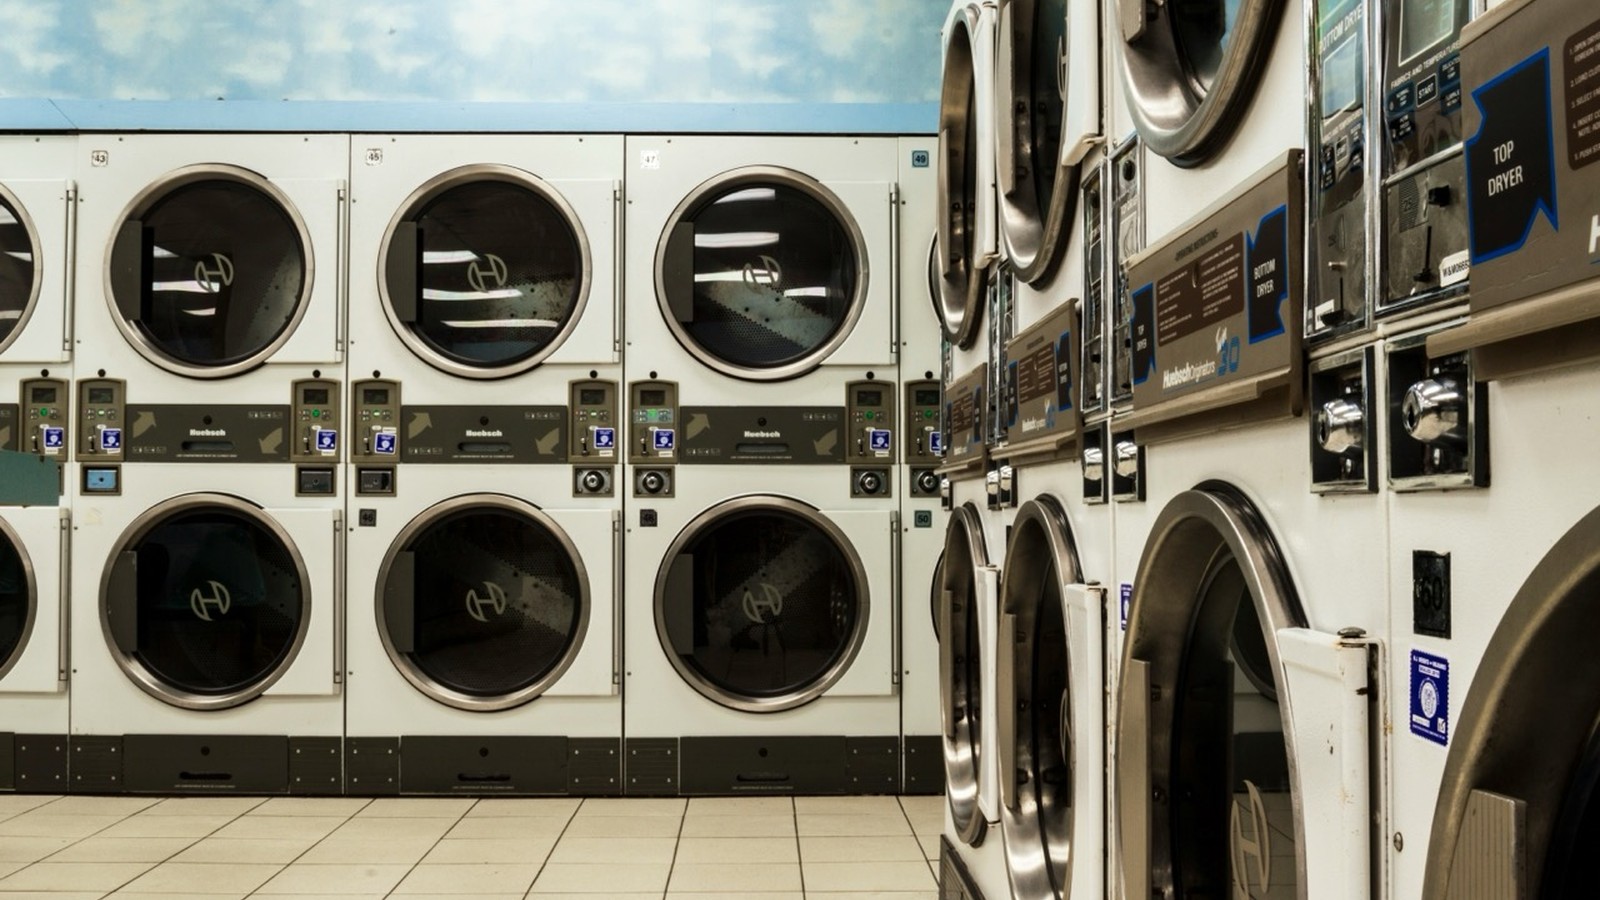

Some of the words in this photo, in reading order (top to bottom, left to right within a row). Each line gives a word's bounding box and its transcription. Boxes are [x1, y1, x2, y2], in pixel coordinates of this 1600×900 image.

[1418, 82, 1434, 99] START
[368, 152, 380, 162] 45
[1493, 140, 1515, 165] TOP
[94, 154, 106, 163] 43
[644, 155, 656, 164] 47
[915, 154, 926, 164] 49
[1487, 165, 1524, 198] DRYER
[1254, 258, 1275, 280] BOTTOM
[1256, 279, 1275, 298] DRYER
[465, 429, 503, 437] Huebsch
[744, 430, 781, 438] Huebsch
[917, 514, 929, 523] 50
